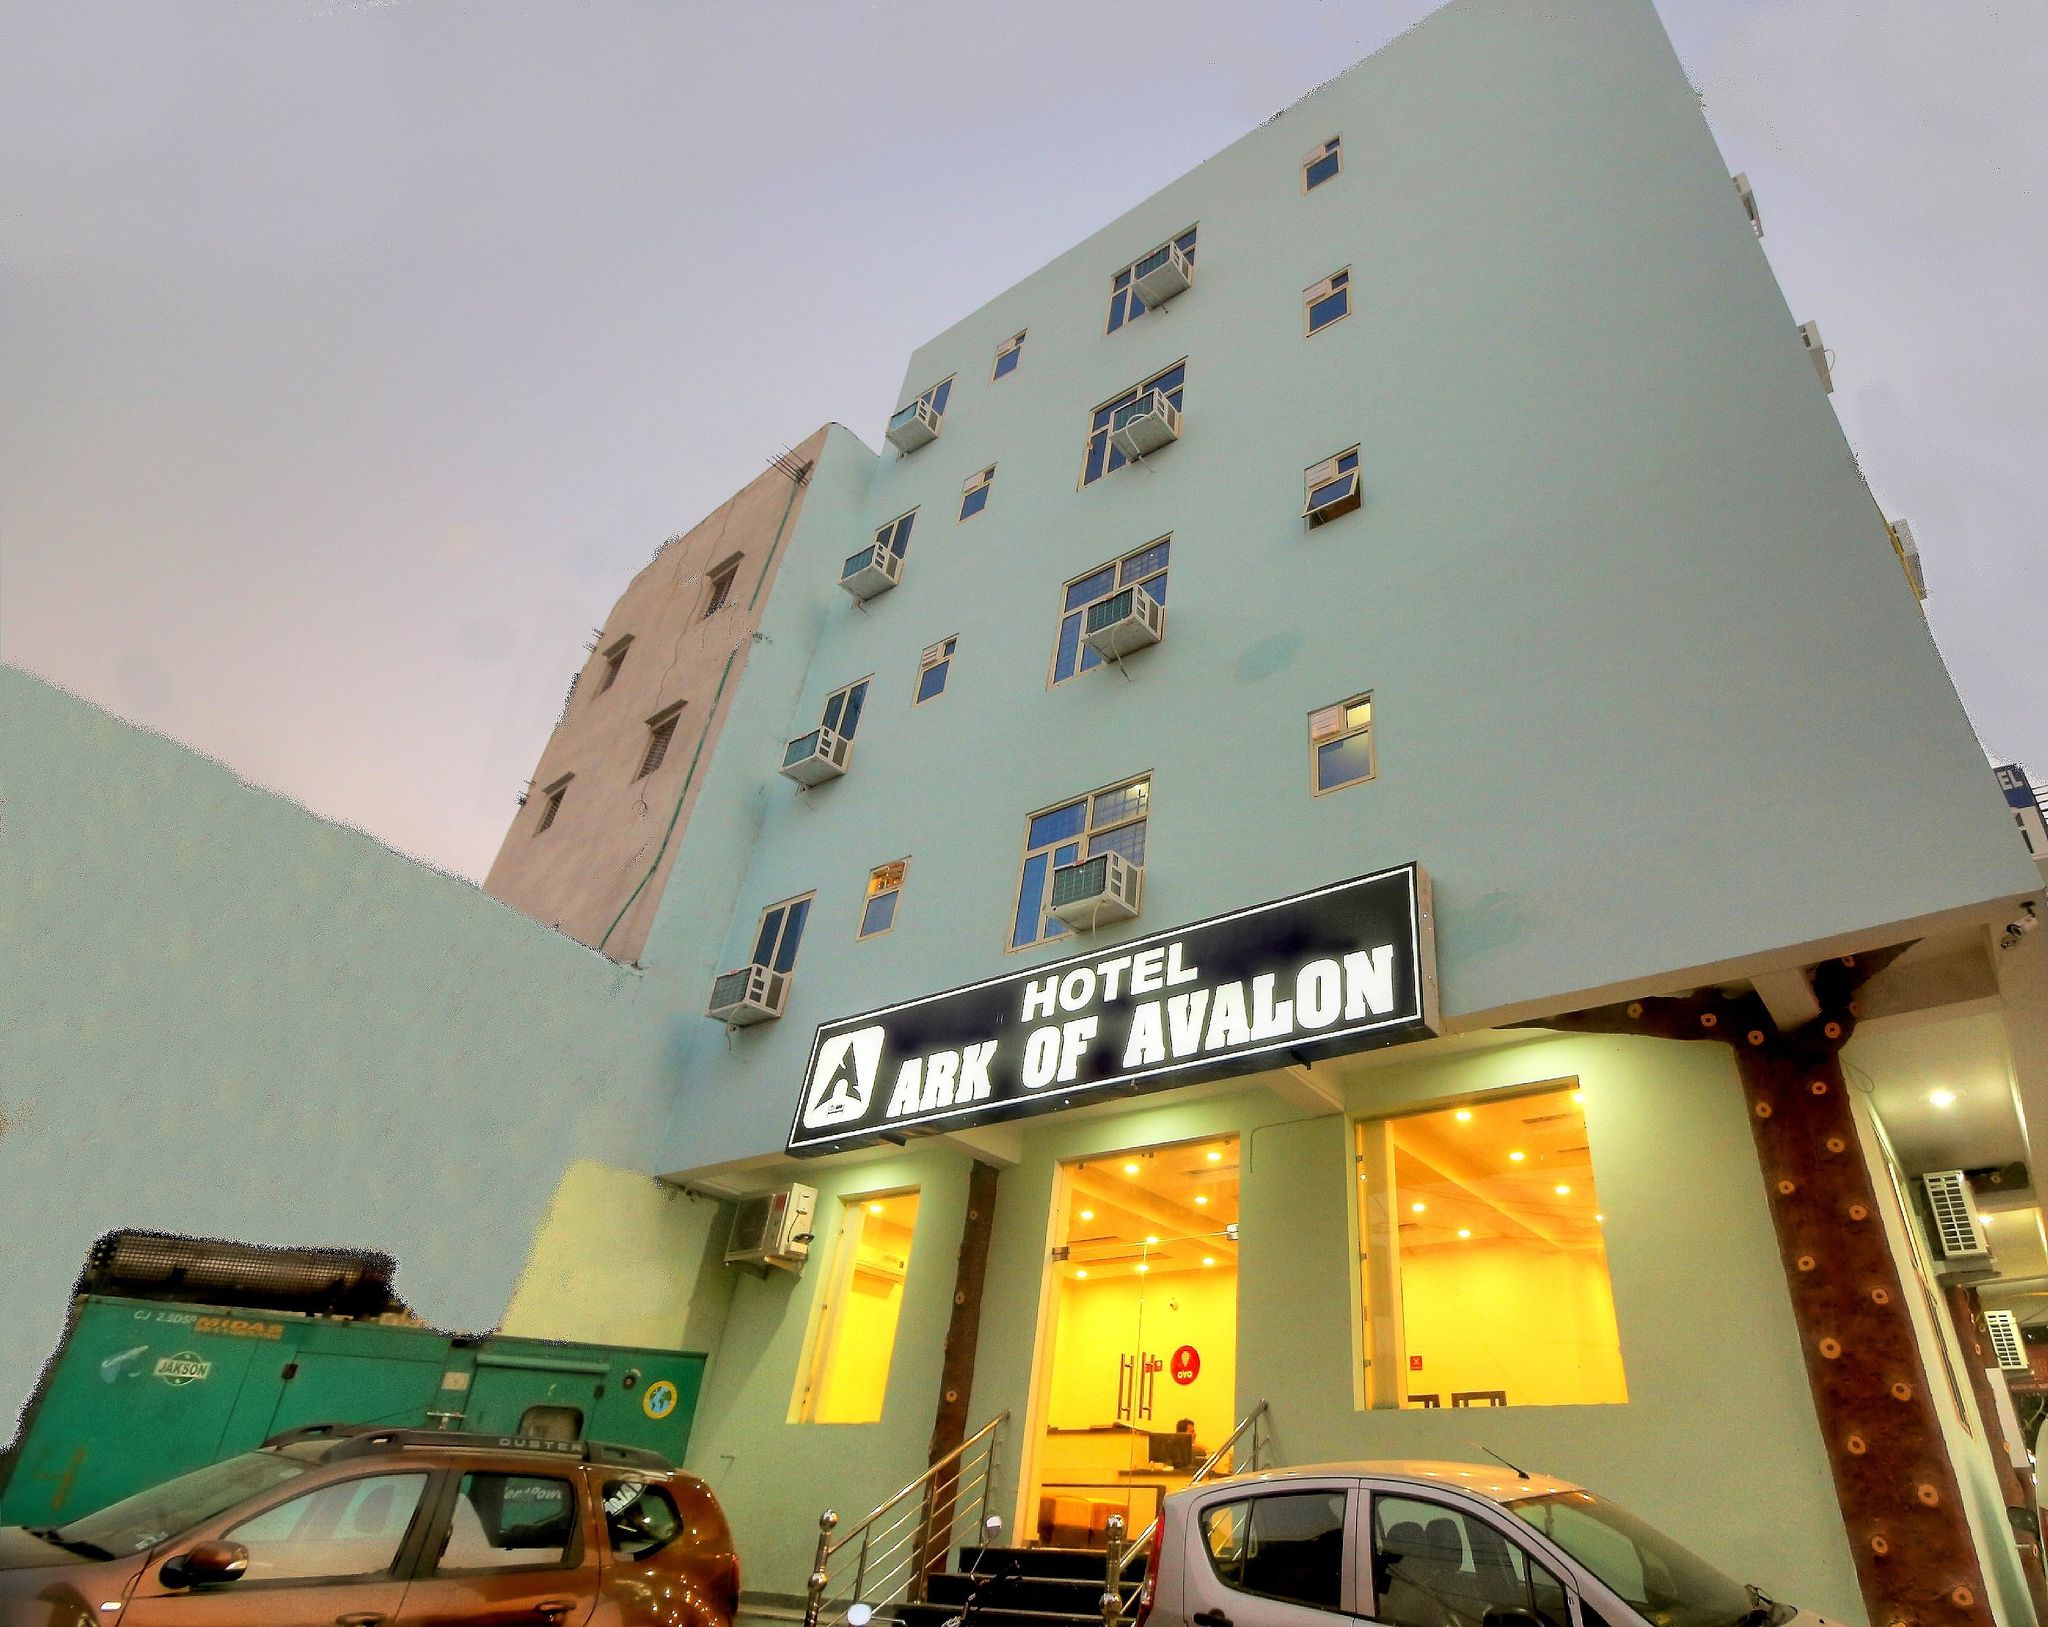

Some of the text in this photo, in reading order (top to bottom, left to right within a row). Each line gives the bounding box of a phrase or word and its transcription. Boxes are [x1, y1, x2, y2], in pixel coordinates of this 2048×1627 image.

[1020, 942, 1199, 1022] HOTEL
[886, 944, 1394, 1118] ARK OF AVALON
[157, 1361, 208, 1376] JAKSON
[1177, 1370, 1193, 1379] OYO
[499, 1437, 583, 1451] DUSTER
